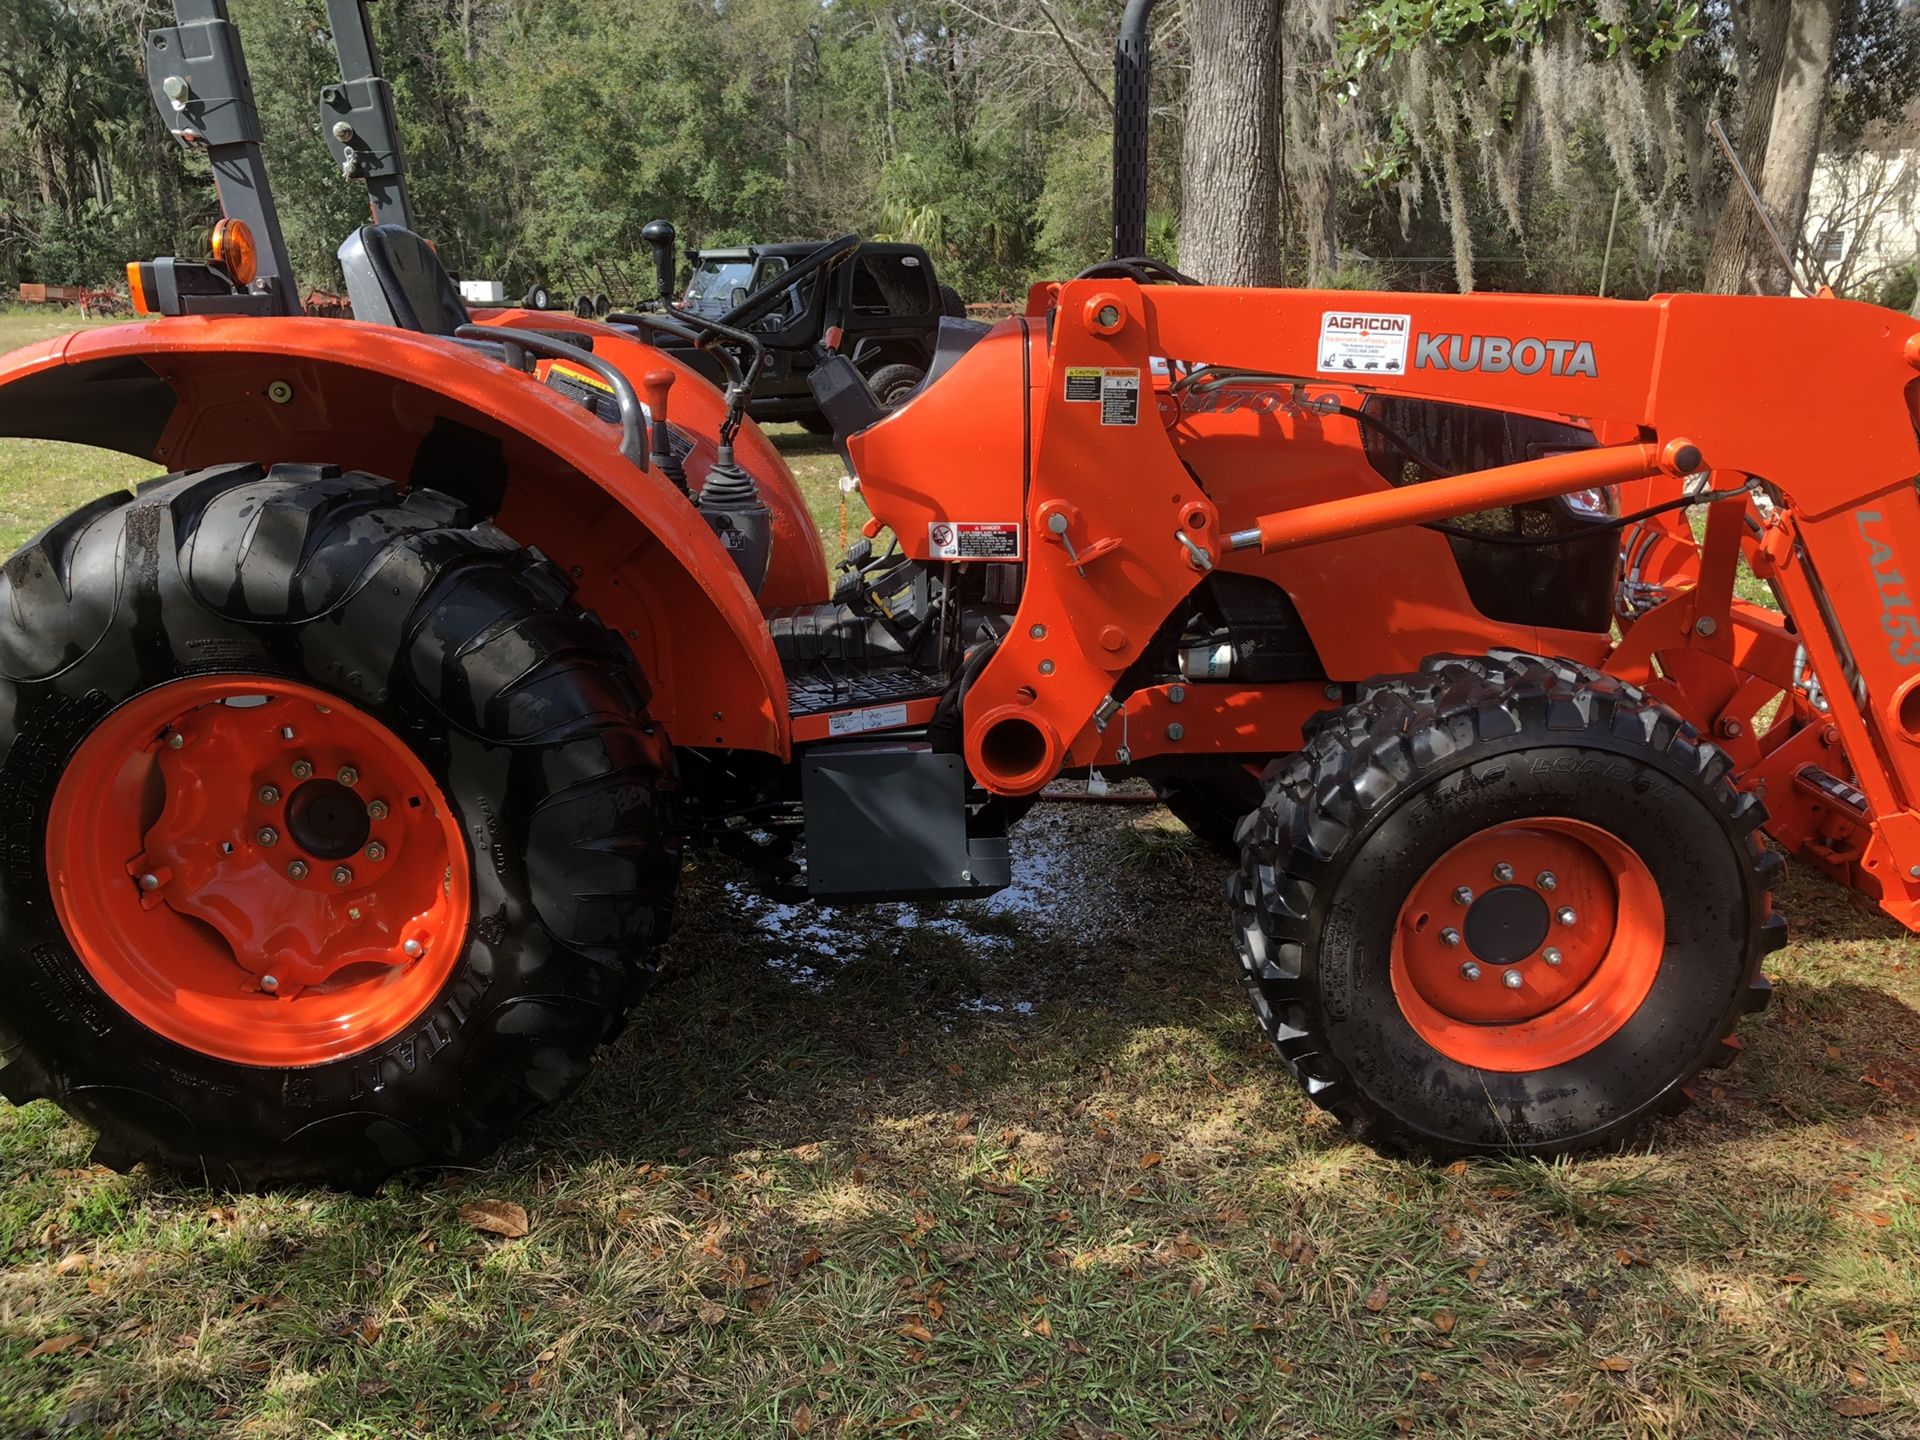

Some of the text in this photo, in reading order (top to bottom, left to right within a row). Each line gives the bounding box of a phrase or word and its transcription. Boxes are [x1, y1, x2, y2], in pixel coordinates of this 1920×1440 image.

[1327, 316, 1405, 331] AGRICON
[1414, 332, 1599, 378] KUBOTA
[1855, 511, 1920, 666] LA1153
[350, 961, 493, 1101] TITAN
